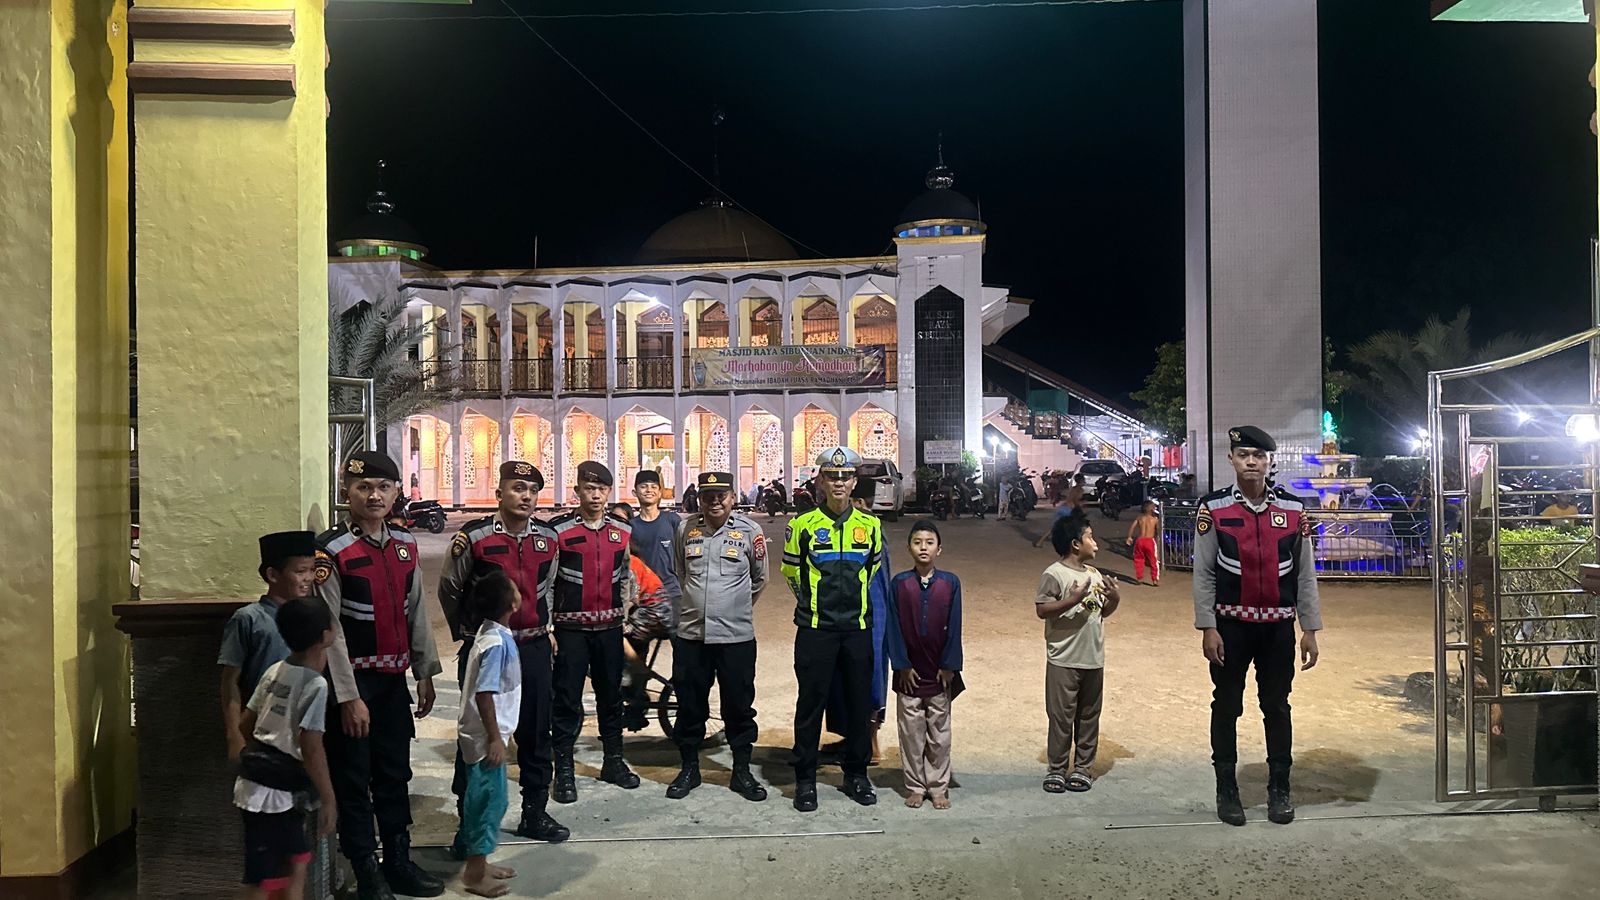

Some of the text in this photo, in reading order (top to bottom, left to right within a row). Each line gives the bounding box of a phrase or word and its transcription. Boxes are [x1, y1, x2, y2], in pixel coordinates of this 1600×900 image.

[719, 348, 752, 358] MASJID
[754, 347, 778, 357] RAYA
[828, 345, 857, 355] INDAH
[767, 376, 789, 384] IBADAH
[723, 540, 746, 549] POLRI
